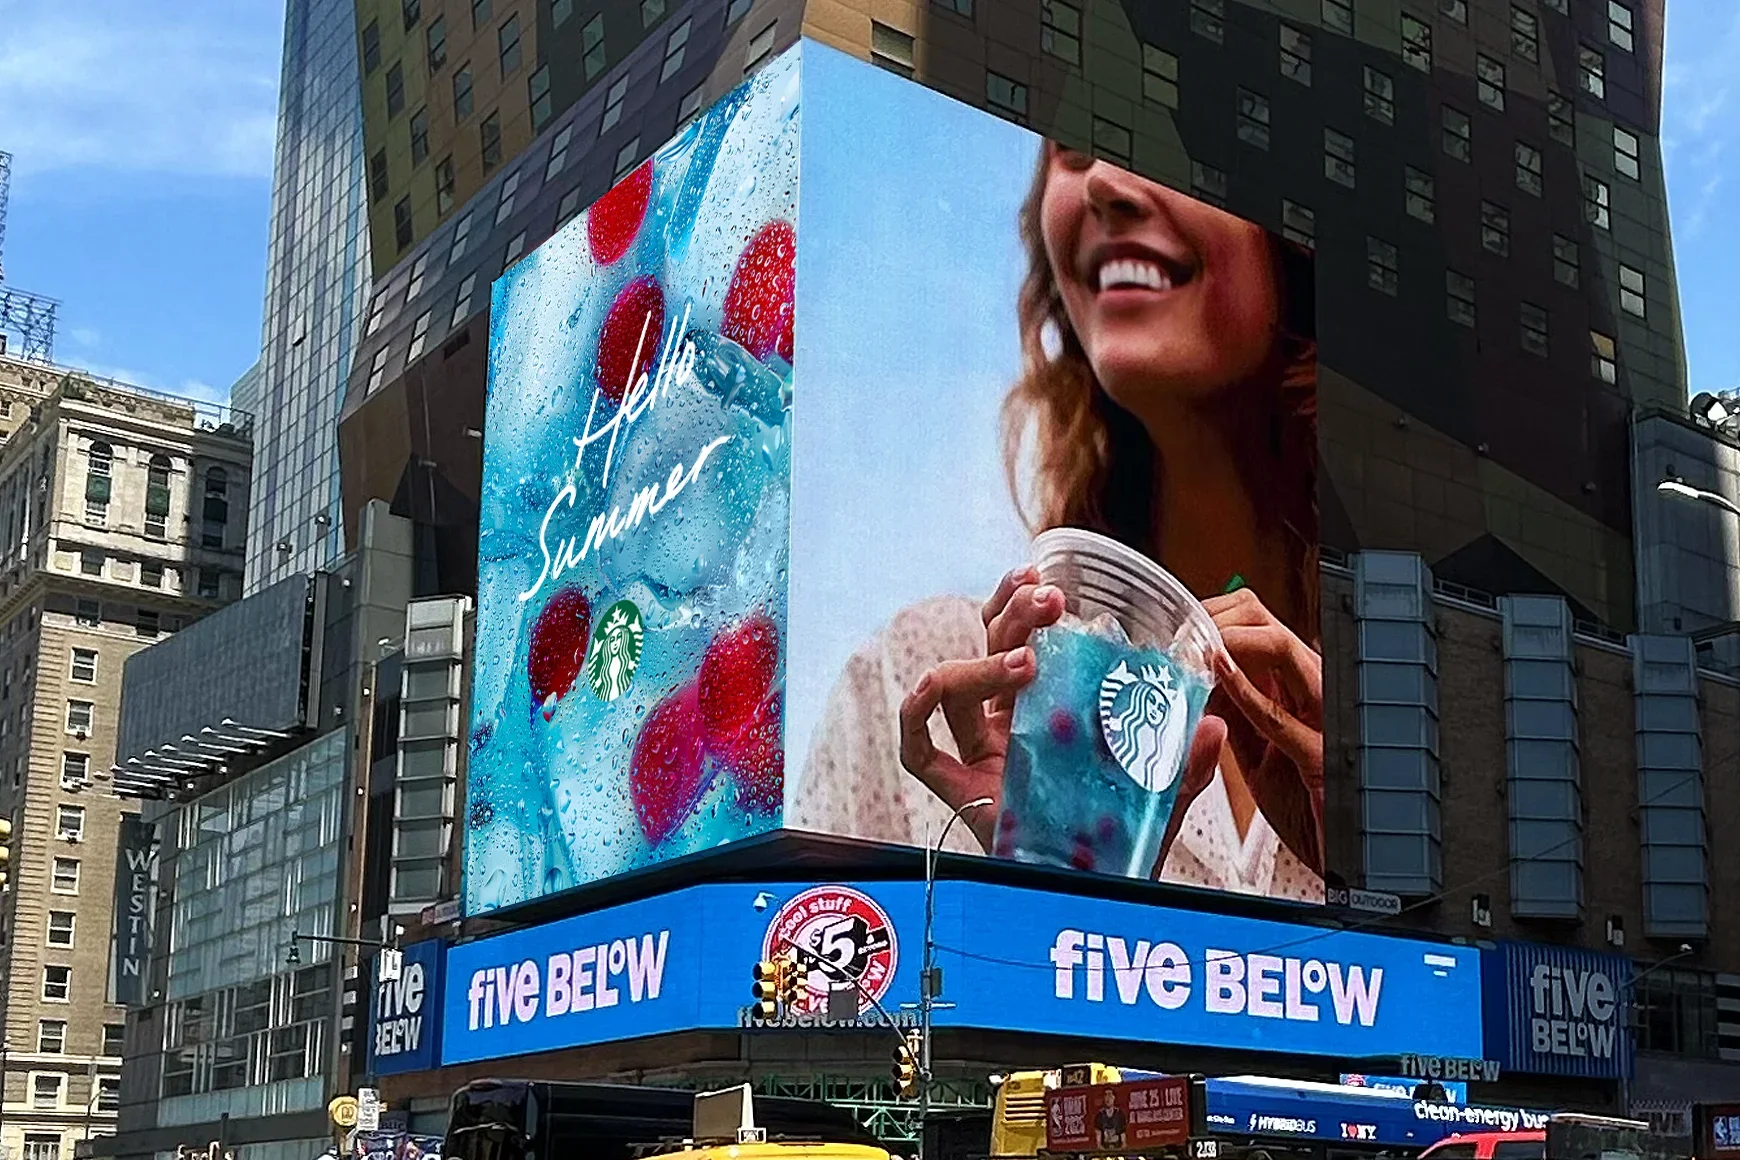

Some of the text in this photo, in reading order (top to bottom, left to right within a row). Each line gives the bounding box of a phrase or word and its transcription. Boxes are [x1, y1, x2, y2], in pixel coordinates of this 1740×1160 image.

[572, 303, 696, 489] Hello
[519, 434, 732, 601] Summer
[121, 847, 157, 977] WESTIN
[809, 896, 852, 914] stuff
[468, 930, 670, 1031] five BELOW
[1050, 929, 1383, 1027] five BELOW
[1530, 964, 1615, 1021] five
[1401, 1053, 1500, 1081] five BELOW
[1532, 1018, 1616, 1058] BELOW
[1414, 1099, 1519, 1131] clean-energy
